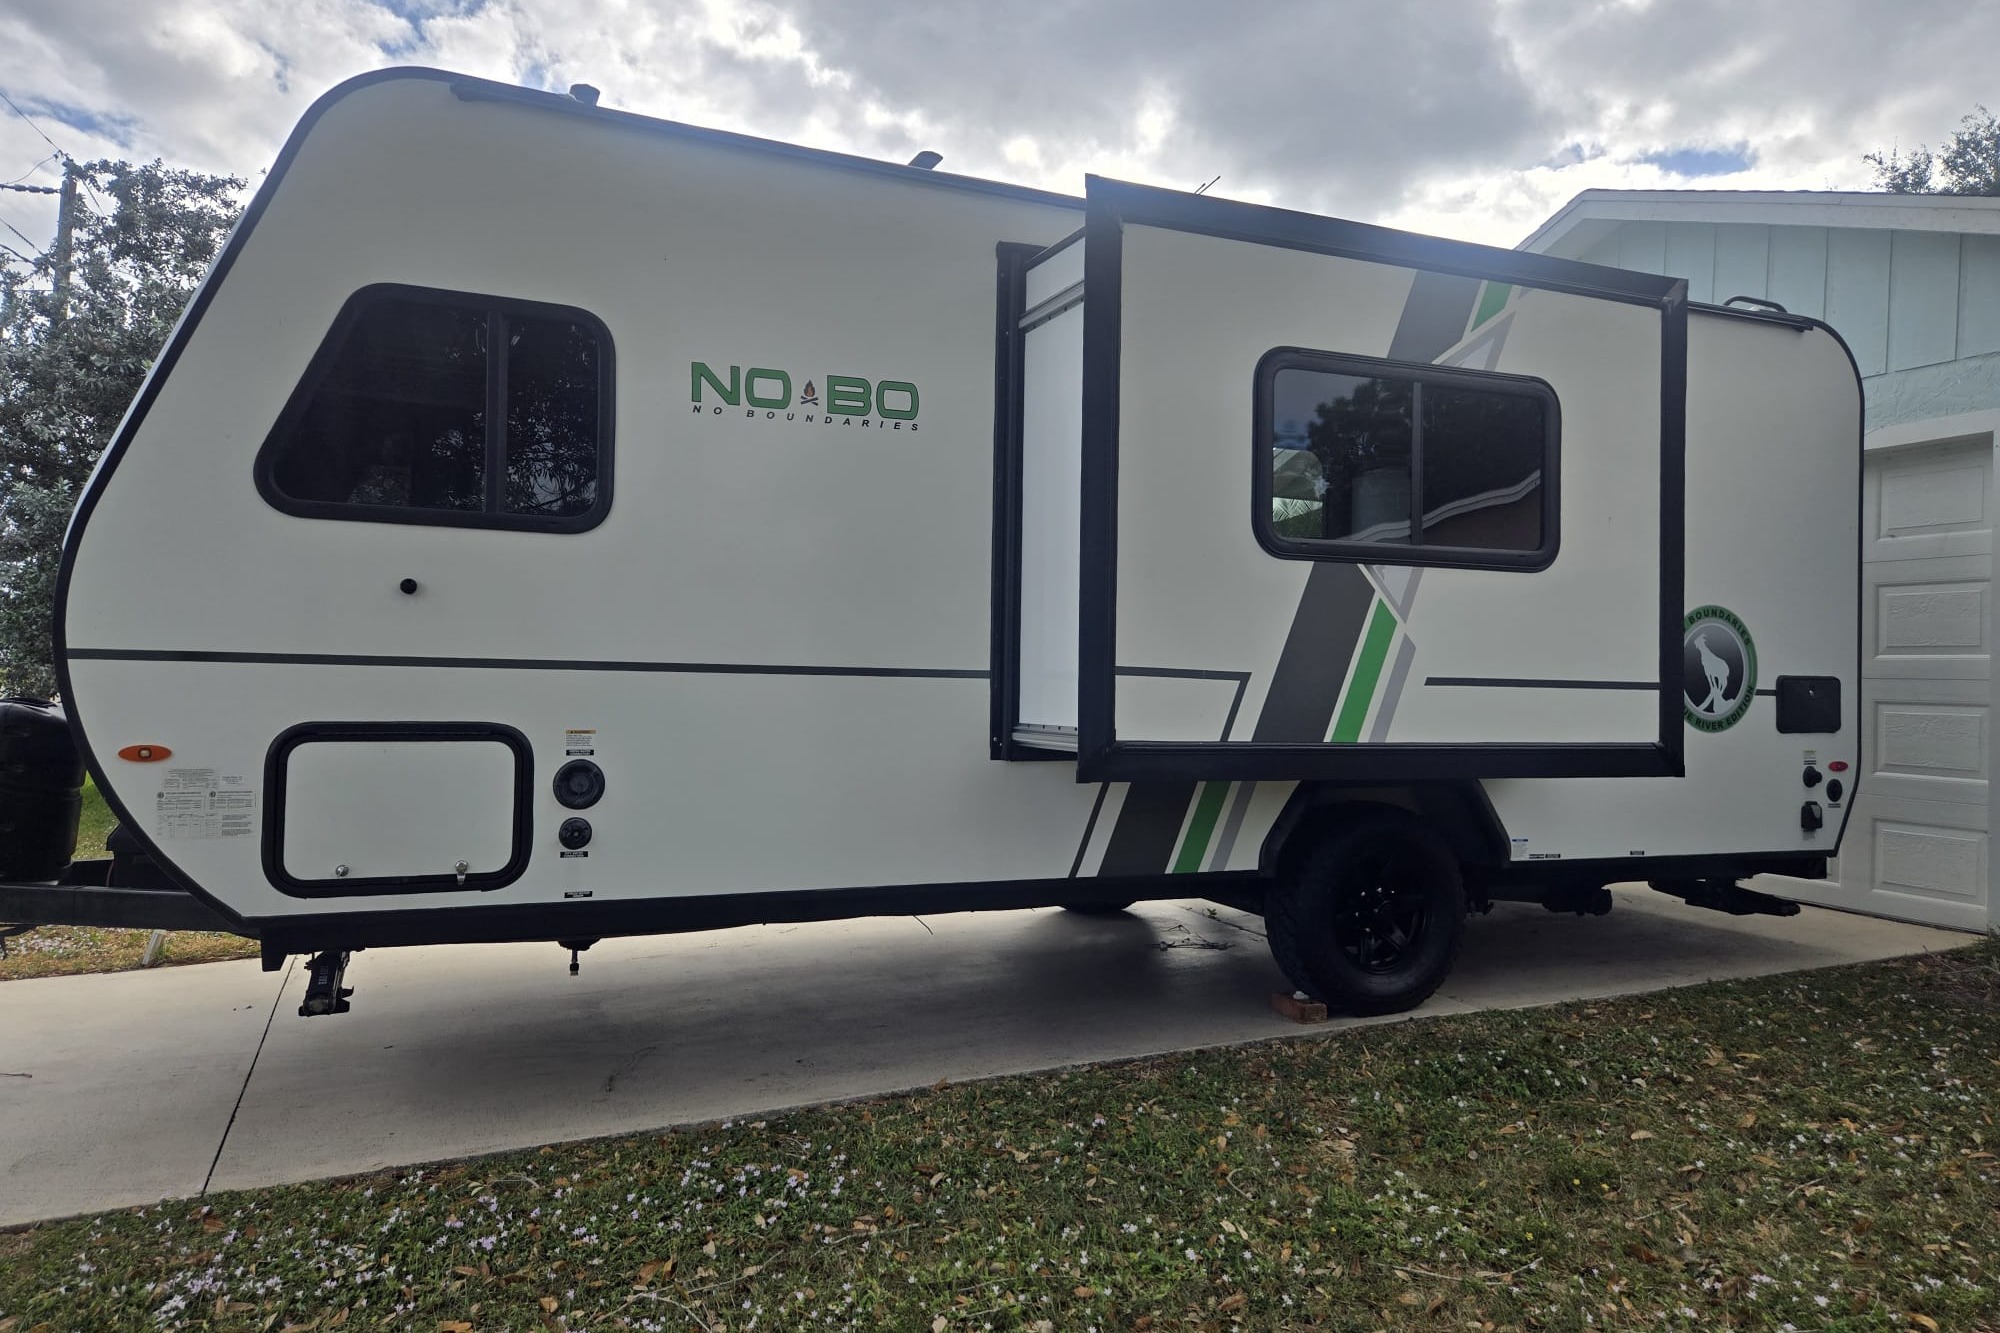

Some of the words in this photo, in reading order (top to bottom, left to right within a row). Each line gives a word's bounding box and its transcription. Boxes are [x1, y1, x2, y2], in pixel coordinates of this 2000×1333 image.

[692, 404, 723, 415] NO
[746, 409, 919, 432] BOUNDARIES
[1688, 608, 1750, 646] BOUNDARIES
[1695, 717, 1724, 731] RIVER
[1726, 685, 1755, 726] EDITION
